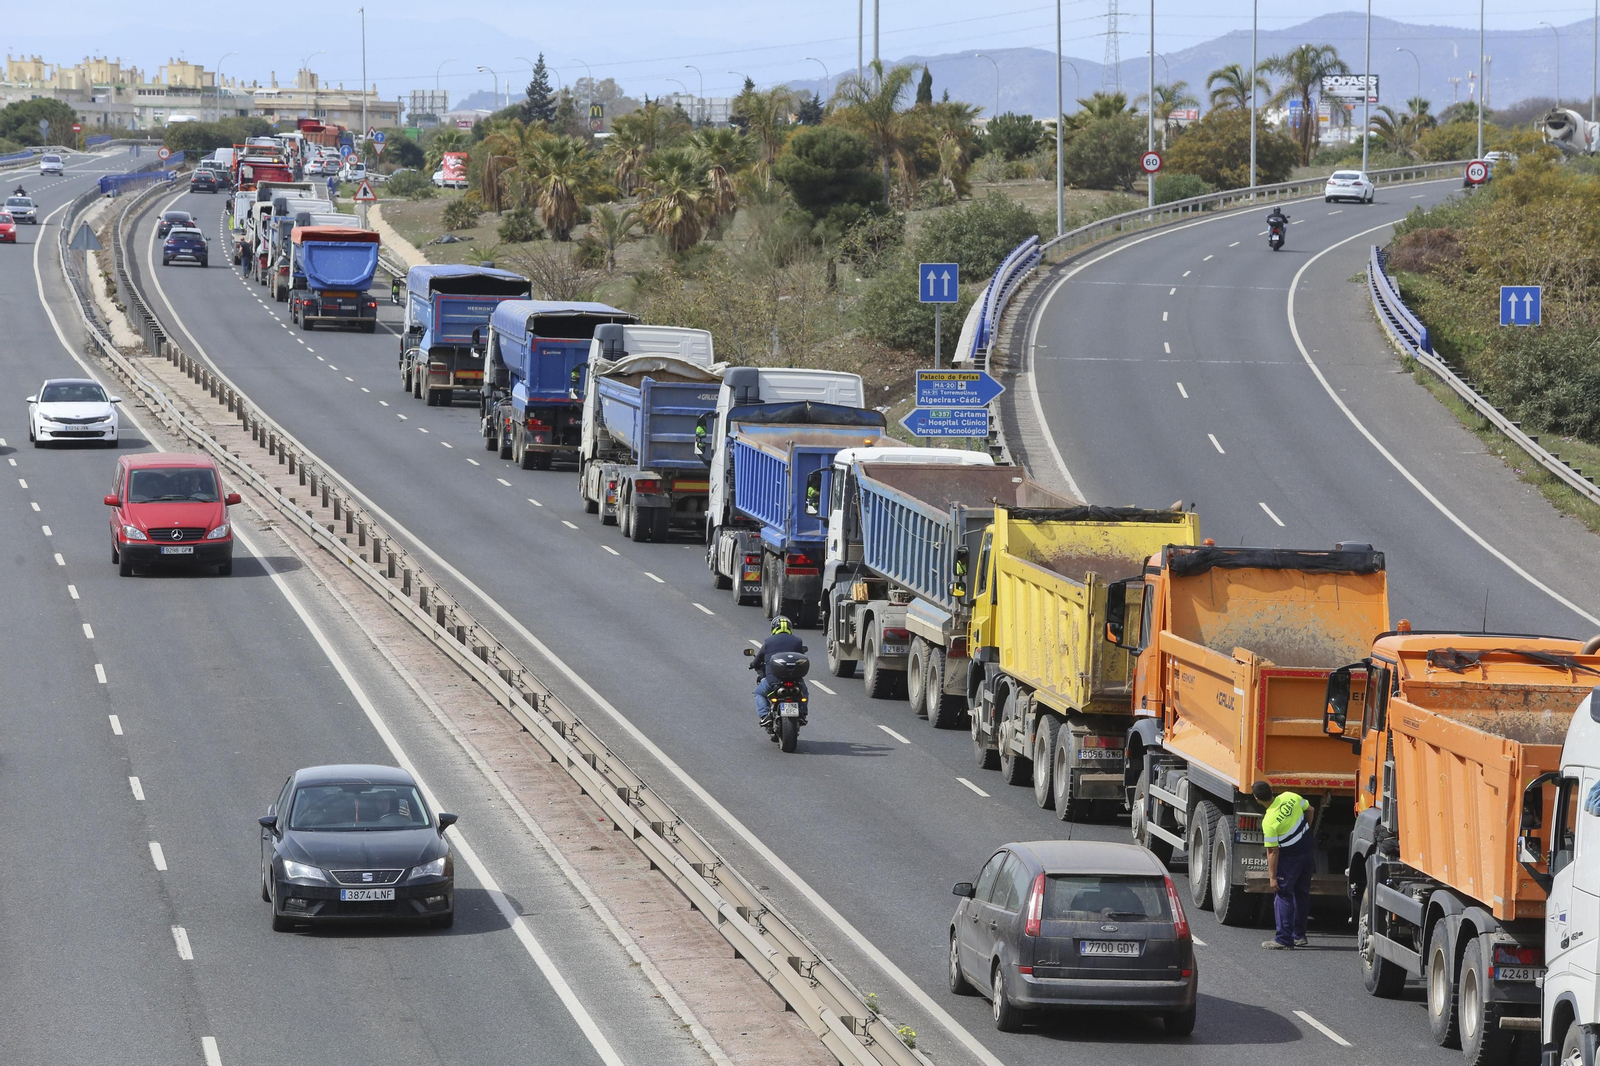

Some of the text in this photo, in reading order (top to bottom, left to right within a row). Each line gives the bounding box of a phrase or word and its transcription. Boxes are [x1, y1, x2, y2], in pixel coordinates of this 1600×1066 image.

[1145, 158, 1158, 166] 60
[1470, 168, 1483, 176] 60
[953, 410, 986, 418] Cártama
[928, 419, 959, 427] Hospital
[917, 426, 987, 436] Parque Tecnológico
[887, 645, 905, 653] 2185
[347, 890, 393, 900] 3874 LNF
[1088, 942, 1135, 953] 7700 GDY
[1501, 969, 1529, 979] 4248
